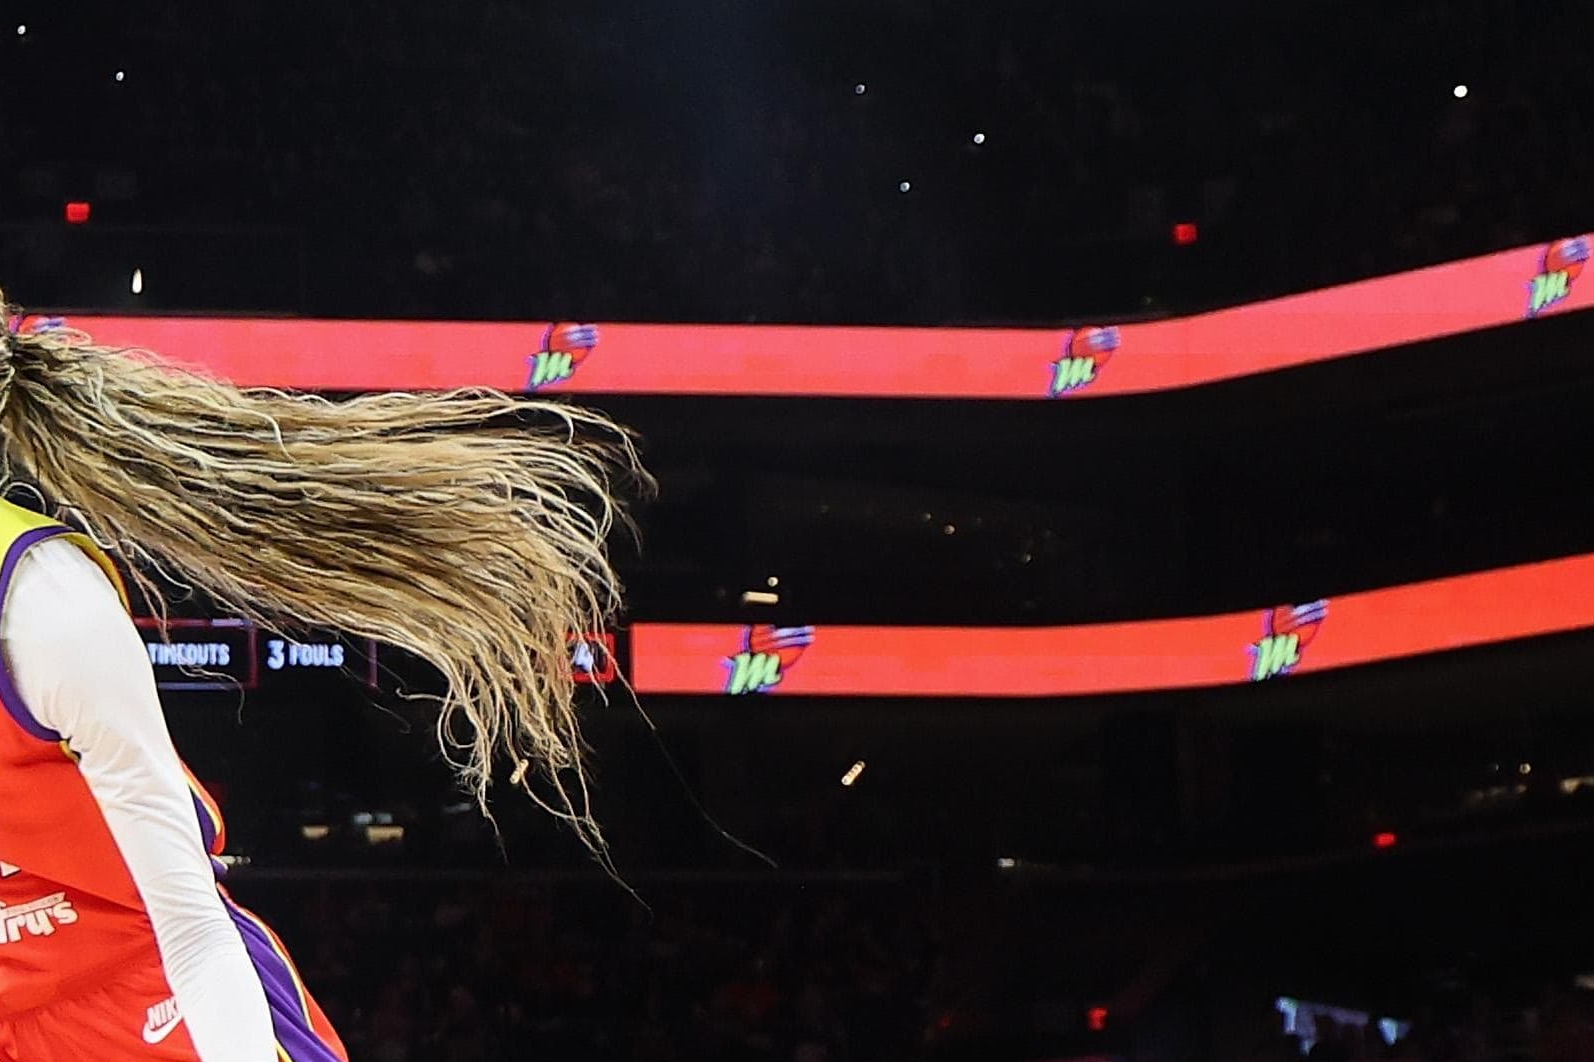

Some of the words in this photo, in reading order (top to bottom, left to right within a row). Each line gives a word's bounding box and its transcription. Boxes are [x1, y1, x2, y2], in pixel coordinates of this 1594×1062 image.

[147, 643, 231, 666] TIMEOUTS
[267, 640, 285, 669] 3
[289, 644, 344, 666] FOULS
